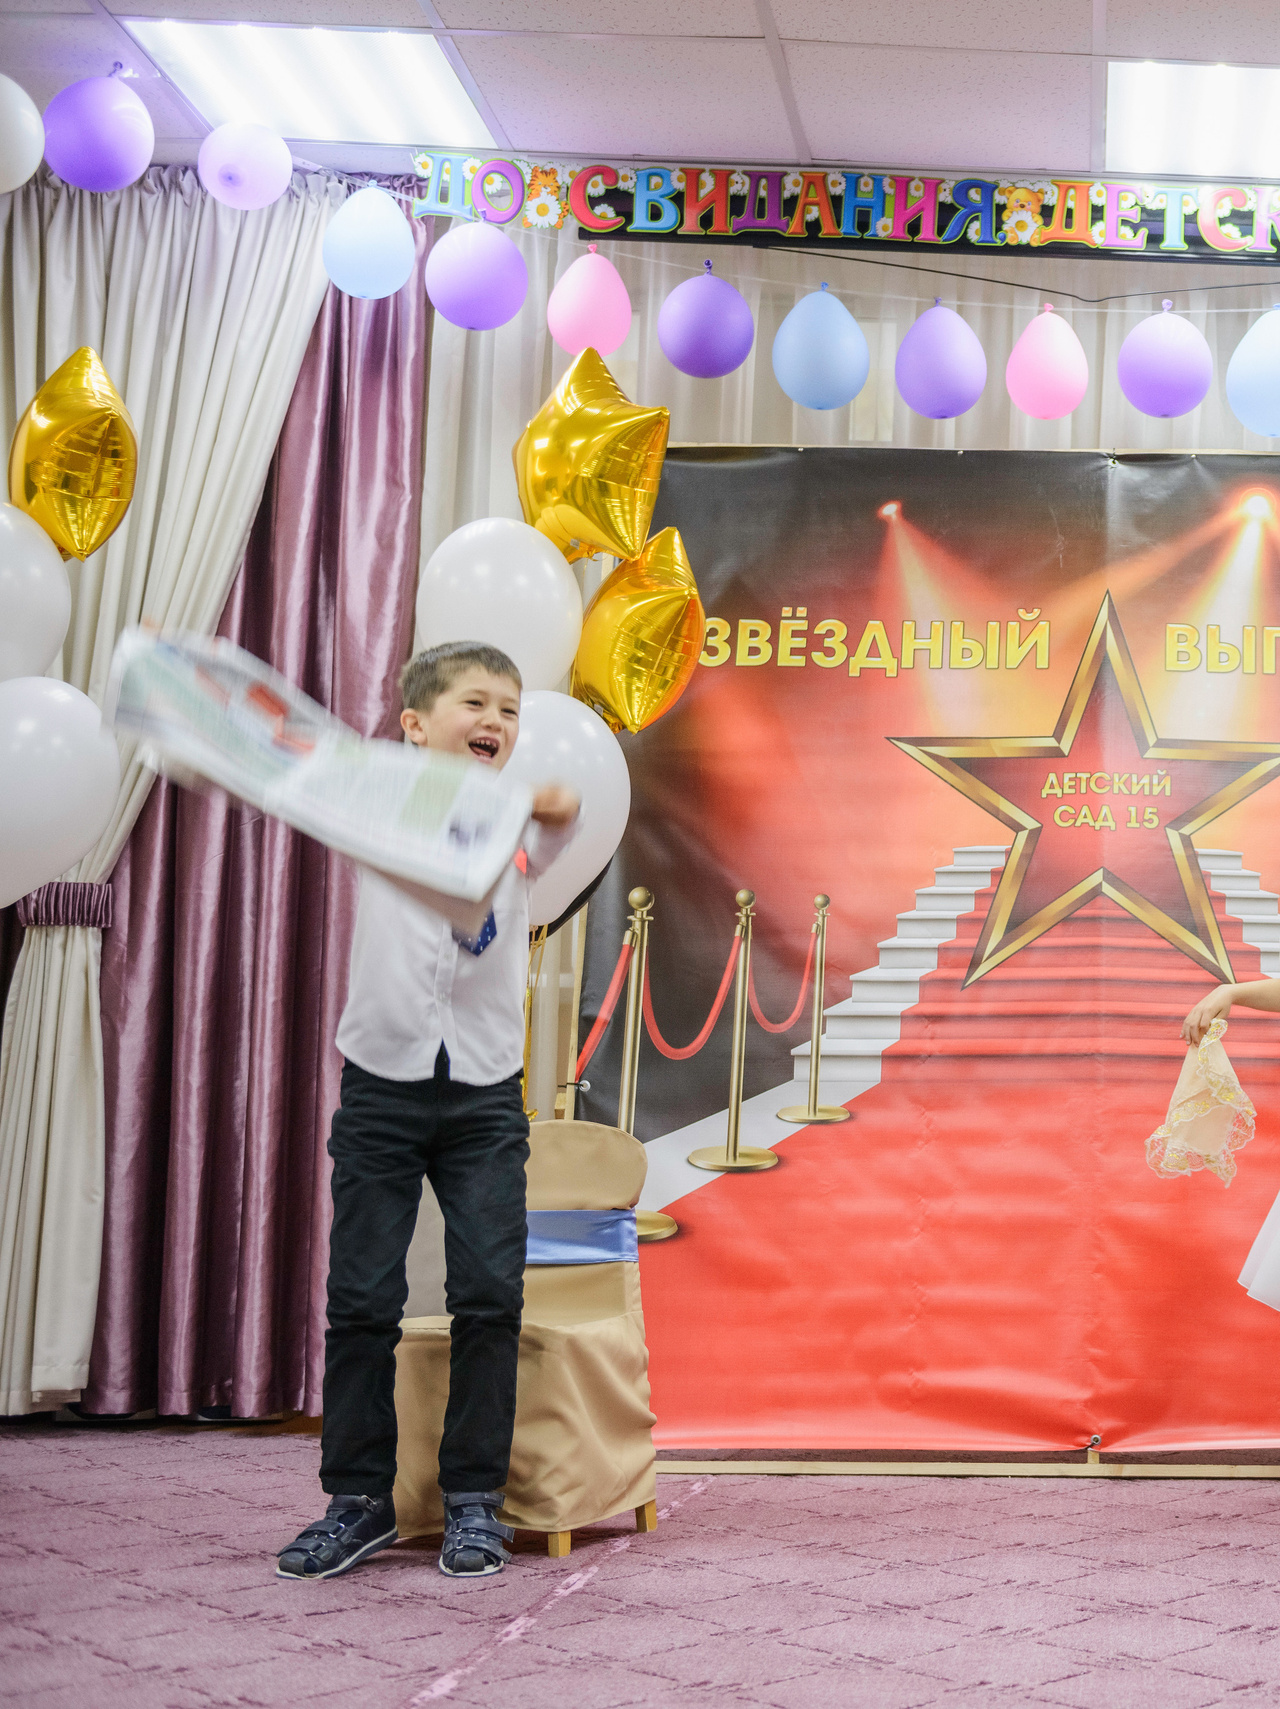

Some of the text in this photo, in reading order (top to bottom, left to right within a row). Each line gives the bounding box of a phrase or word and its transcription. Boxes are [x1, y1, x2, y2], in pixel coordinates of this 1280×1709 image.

[412, 151, 526, 225] ДО
[698, 606, 1051, 678] ЗВЁЗДНЫЙ
[1041, 769, 1172, 799] ДЕТСКИЙ
[1053, 804, 1160, 831] САД 15
